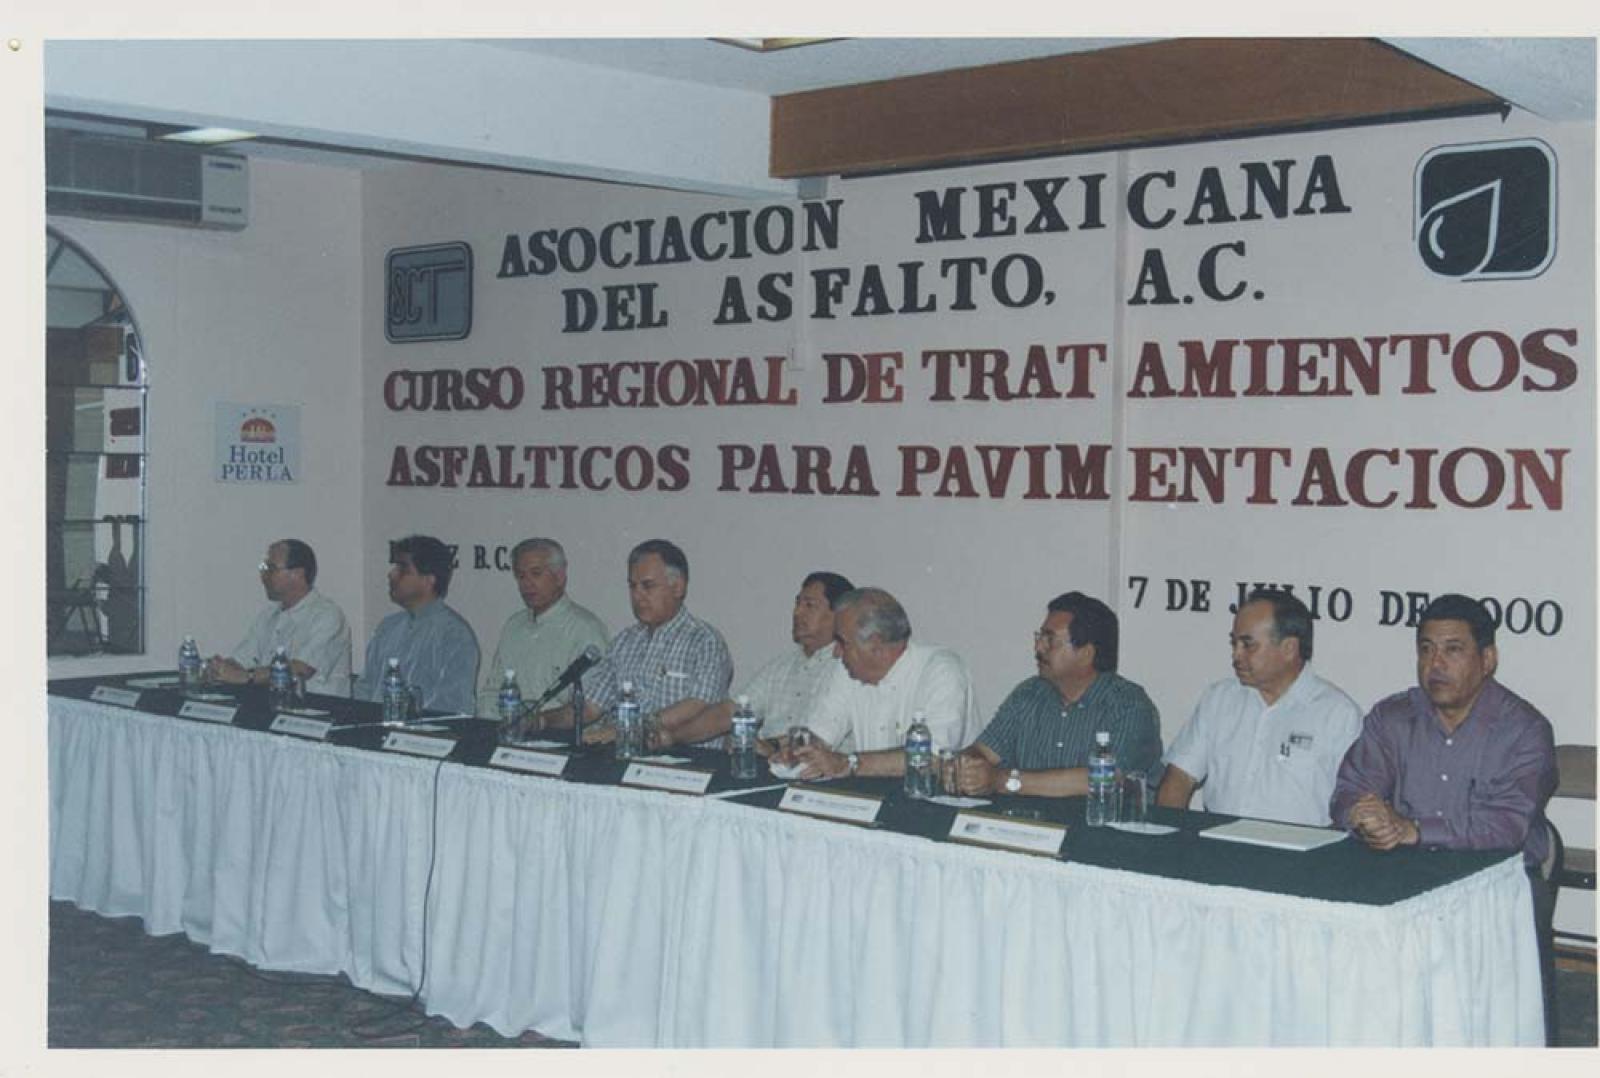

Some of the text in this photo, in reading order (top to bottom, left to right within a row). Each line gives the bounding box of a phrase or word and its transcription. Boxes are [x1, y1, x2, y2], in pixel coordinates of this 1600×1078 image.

[497, 154, 1352, 278] ASOCIACION MEXICANA
[388, 259, 465, 326] SCT
[561, 283, 668, 333] DEL
[1127, 240, 1265, 306] A.C.
[383, 366, 525, 411] CURSO
[541, 355, 798, 410] REGIONAL
[822, 352, 904, 403] DE
[221, 464, 293, 481] PERLA
[229, 445, 285, 464] Hotel
[386, 444, 691, 492] ASFALTICOS
[717, 444, 881, 497] PARA
[1127, 576, 1149, 609] 7
[1165, 578, 1212, 612] DE
[1229, 582, 1353, 622] JIO
[1478, 597, 1564, 637] 000
